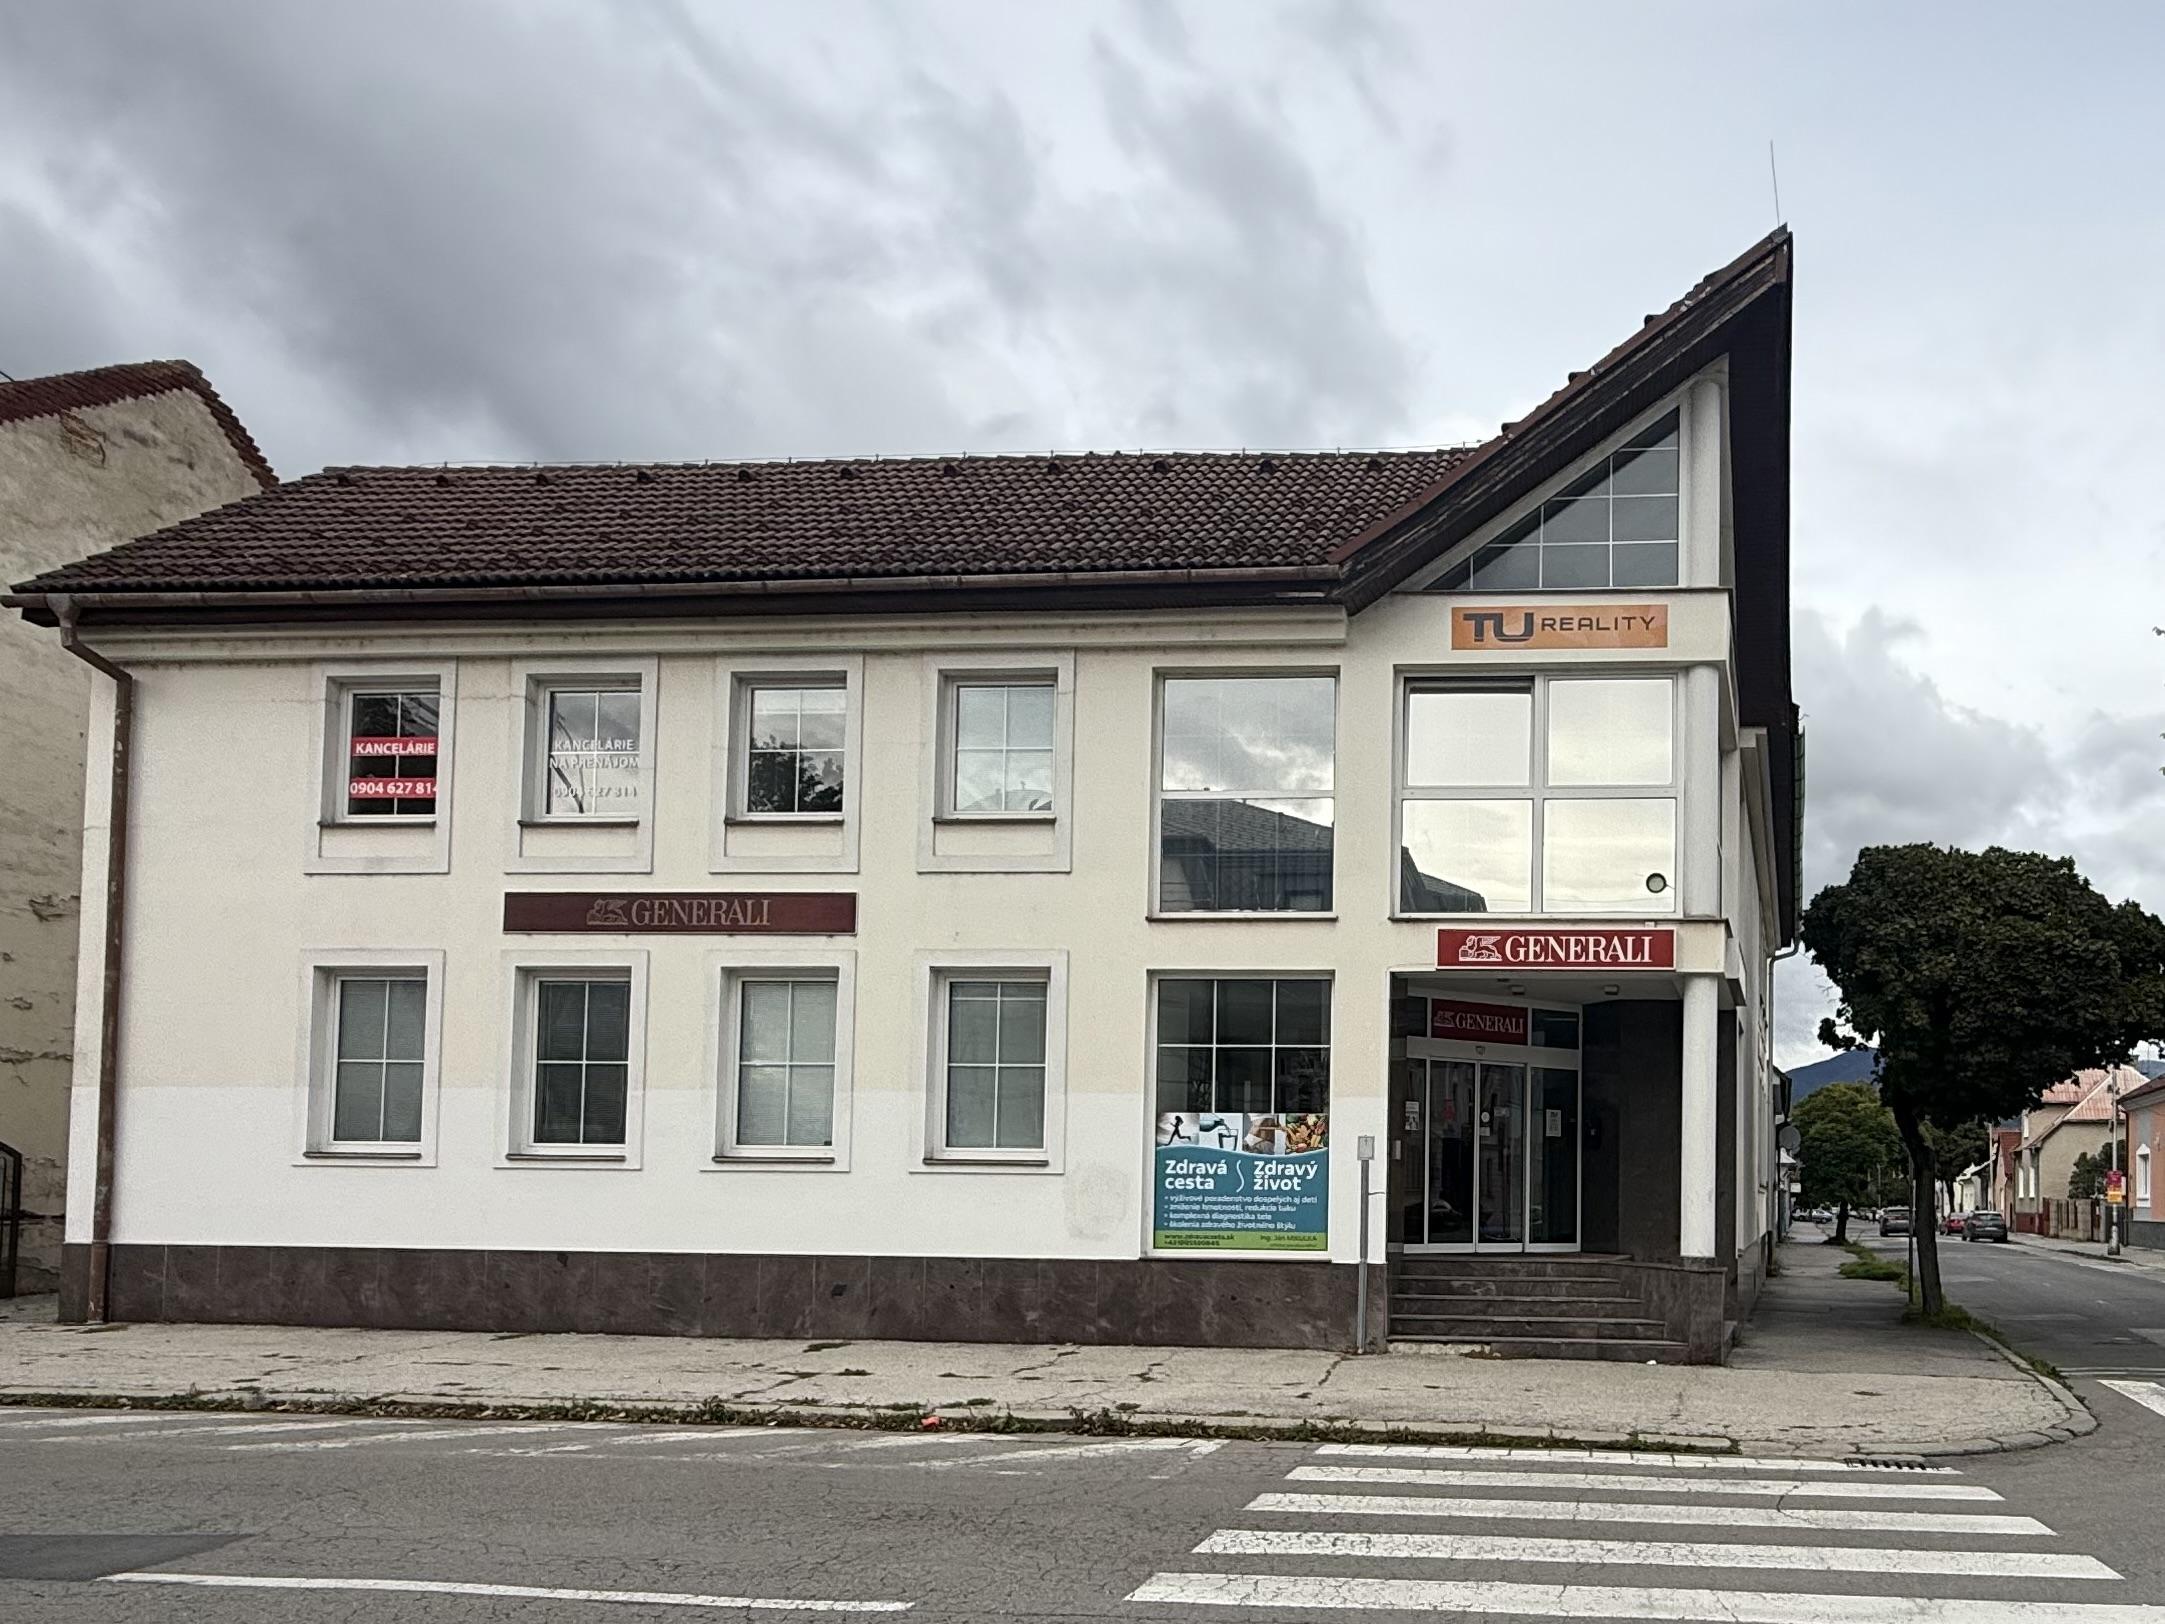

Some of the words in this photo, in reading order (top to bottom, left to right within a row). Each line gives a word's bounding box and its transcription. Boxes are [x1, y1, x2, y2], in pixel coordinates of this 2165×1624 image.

[1463, 612, 1534, 642] TU
[1541, 616, 1656, 632] REALITY
[356, 741, 435, 754] KANCELÁRIE
[554, 738, 634, 751] KANCELÁRIE
[350, 781, 384, 794] 0904
[387, 782, 412, 794] 627
[631, 898, 772, 926] GENERALI
[1505, 935, 1653, 963] GENERALI
[1456, 1012, 1524, 1034] GENERALI
[1165, 1159, 1228, 1175] Zdravá
[1253, 1160, 1318, 1180] Zdravý
[1165, 1175, 1215, 1190] cesta
[1253, 1175, 1302, 1191] život
[1293, 1196, 1301, 1205] aj
